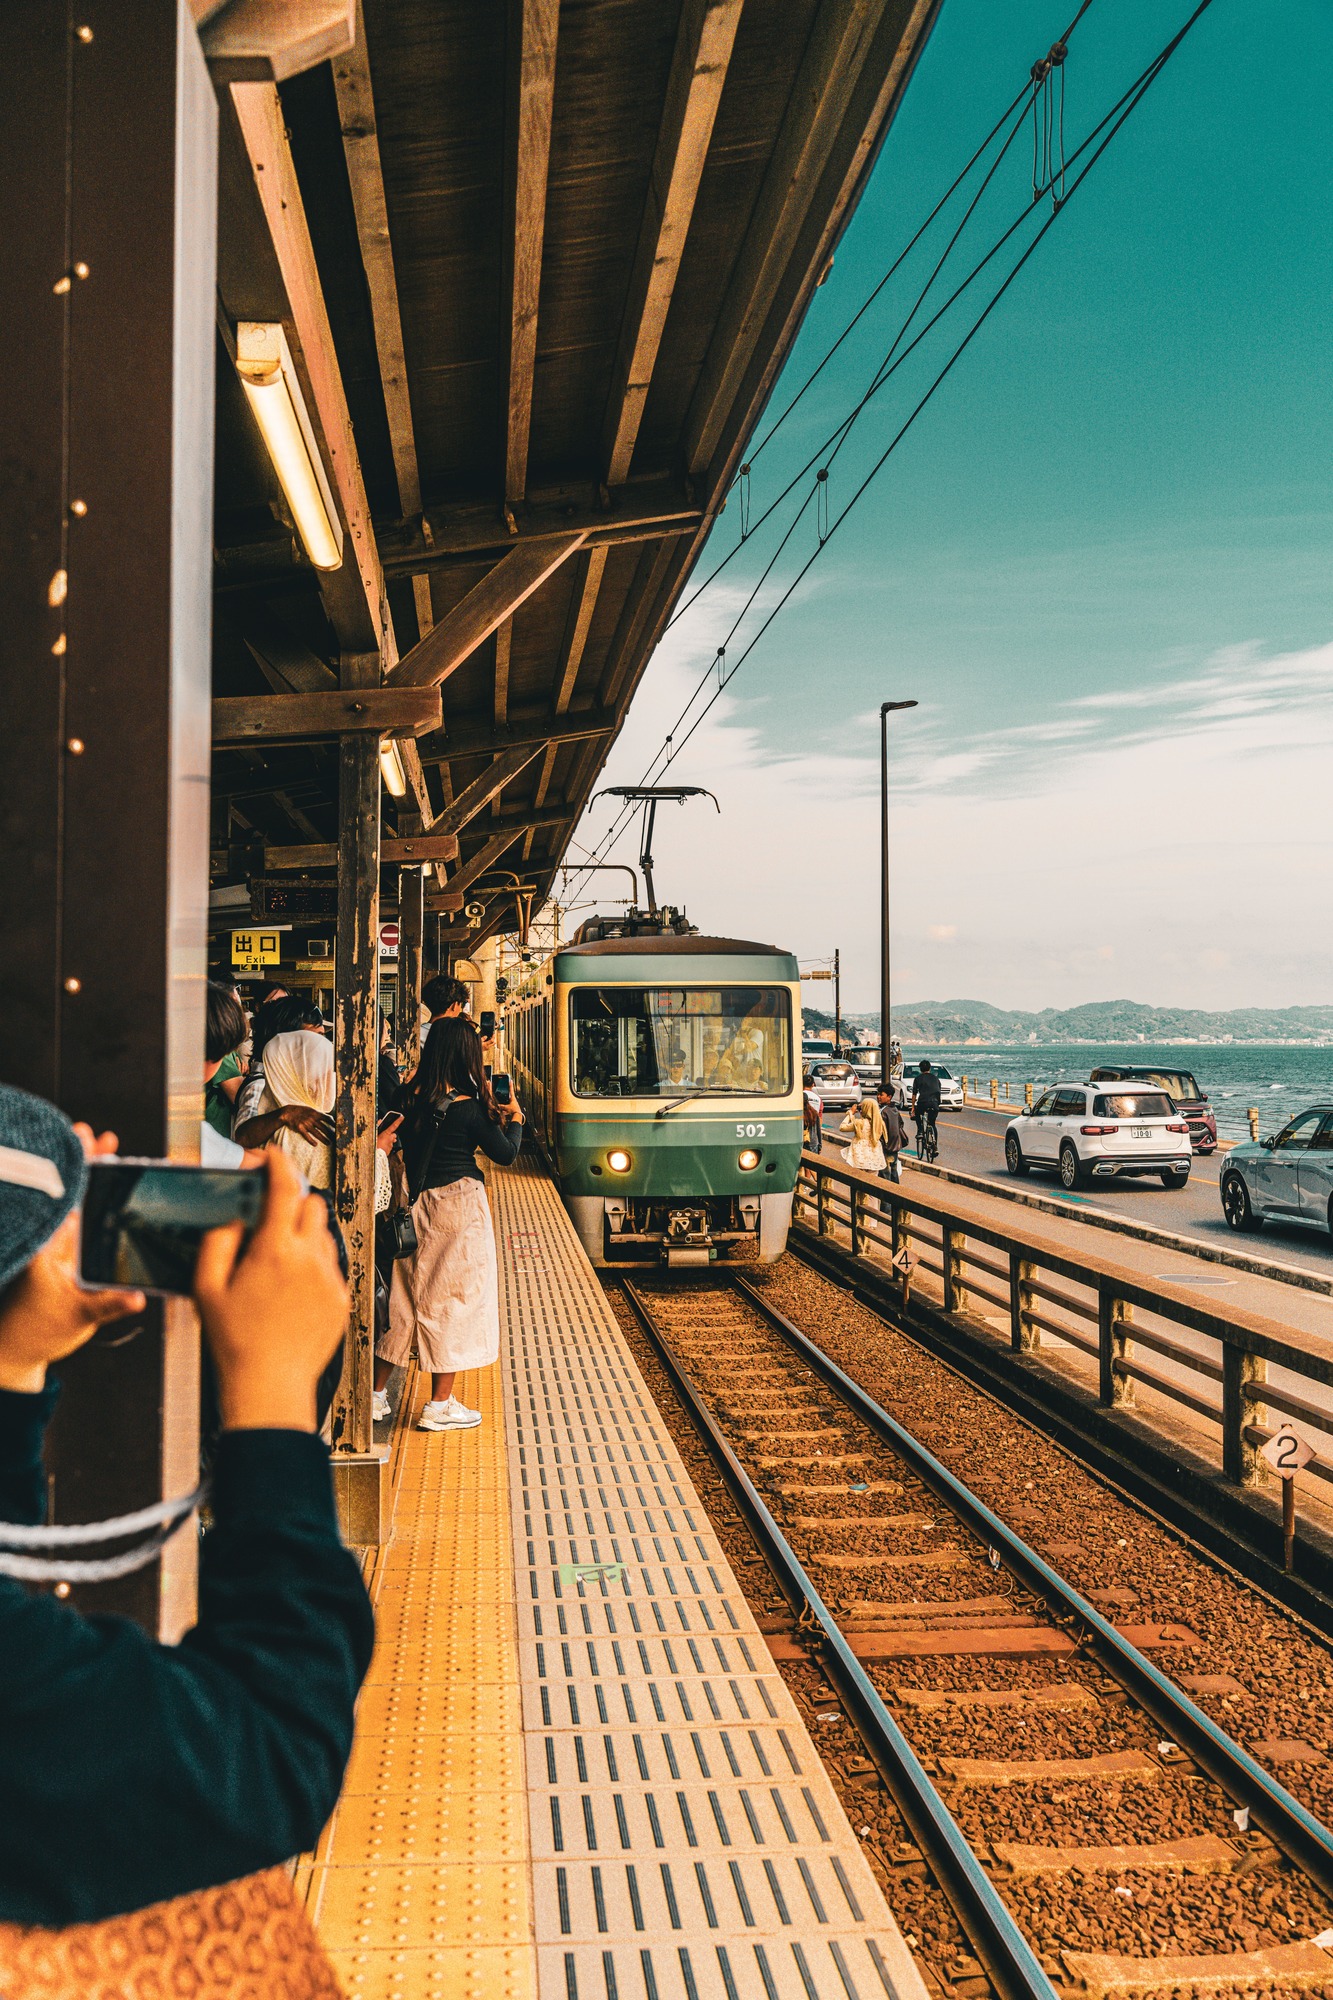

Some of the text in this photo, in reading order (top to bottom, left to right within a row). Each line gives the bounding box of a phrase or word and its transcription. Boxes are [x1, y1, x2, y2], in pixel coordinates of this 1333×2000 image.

[235, 935, 276, 952] 出口
[246, 955, 265, 964] Exit
[736, 1123, 766, 1138] 502
[898, 1250, 912, 1269] 4
[1277, 1435, 1298, 1469] 2
